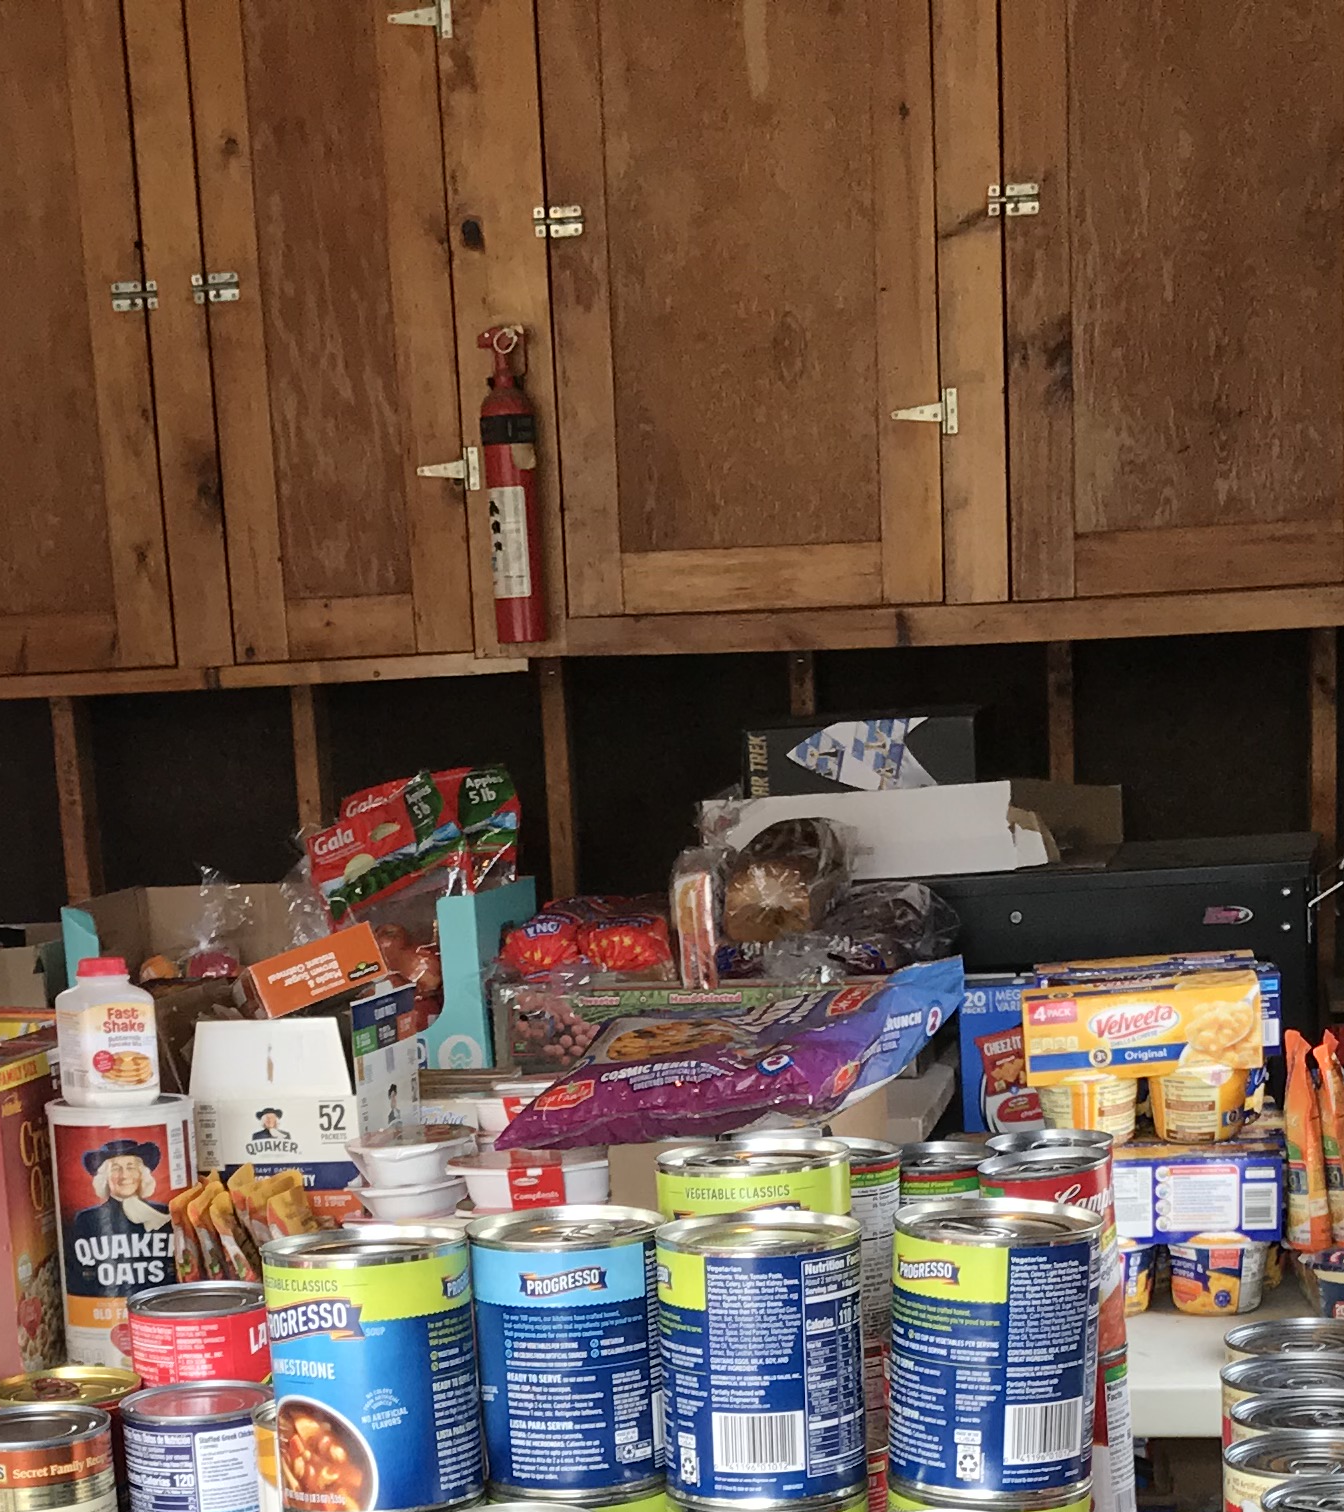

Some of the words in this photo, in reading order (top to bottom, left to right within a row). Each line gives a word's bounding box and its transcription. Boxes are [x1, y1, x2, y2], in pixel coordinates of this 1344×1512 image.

[748, 734, 768, 771] TREK
[465, 774, 503, 789] Apples
[469, 792, 479, 804] 5
[481, 790, 496, 802] lb
[314, 828, 354, 855] Gala
[964, 992, 986, 1007] 20
[107, 1007, 139, 1020] Fast
[1033, 1008, 1046, 1021] 4
[1047, 1006, 1071, 1018] PACK
[1096, 1004, 1174, 1038] Velveeta
[103, 1020, 145, 1034] Shake
[1124, 1048, 1167, 1061] Original
[601, 1062, 649, 1083] COSMIC
[318, 1104, 346, 1132] 52
[320, 1132, 348, 1141] PACKETS
[245, 1141, 299, 1156] QUAKER
[685, 1187, 736, 1200] VEGETABLE
[739, 1184, 790, 1199] CLASSICS
[97, 1261, 165, 1285] OATS
[900, 1260, 953, 1278] PROGRESSO
[526, 1270, 600, 1296] PROGRESSO
[507, 1373, 526, 1383] READY
[528, 1374, 536, 1382] TO
[538, 1373, 562, 1383] SERVE
[13, 1467, 47, 1481] Secret
[49, 1461, 85, 1478] Family
[173, 1472, 195, 1487] 120
